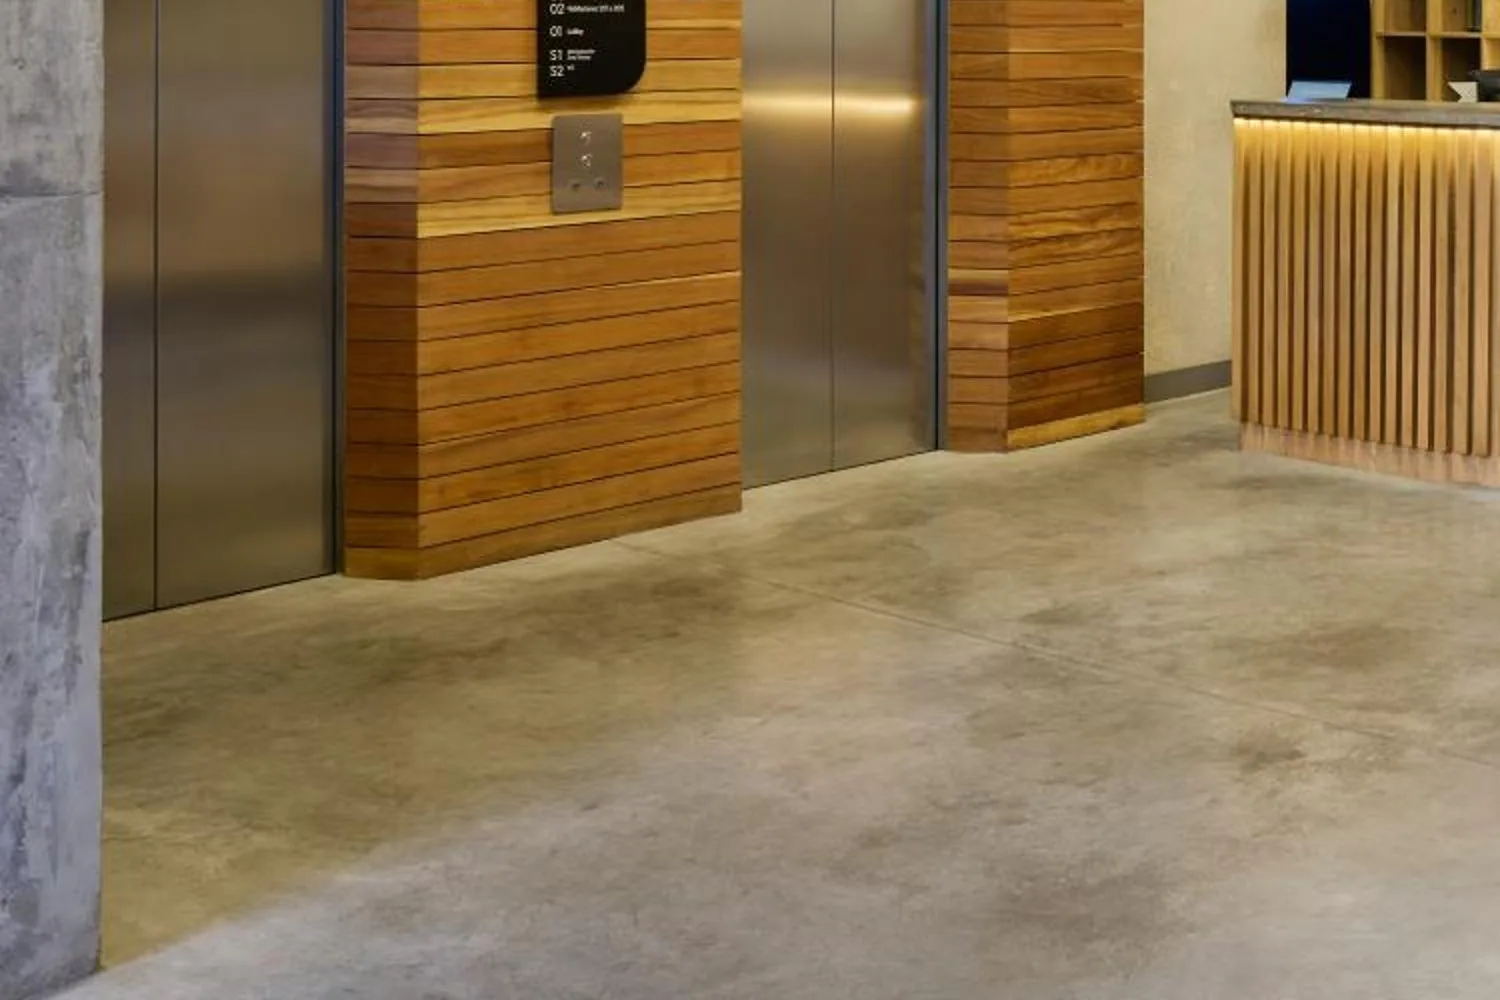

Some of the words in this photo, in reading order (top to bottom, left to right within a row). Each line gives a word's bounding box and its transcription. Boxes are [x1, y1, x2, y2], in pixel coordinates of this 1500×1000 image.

[549, 3, 565, 15] 02
[549, 49, 563, 61] S1
[549, 65, 565, 77] S2
